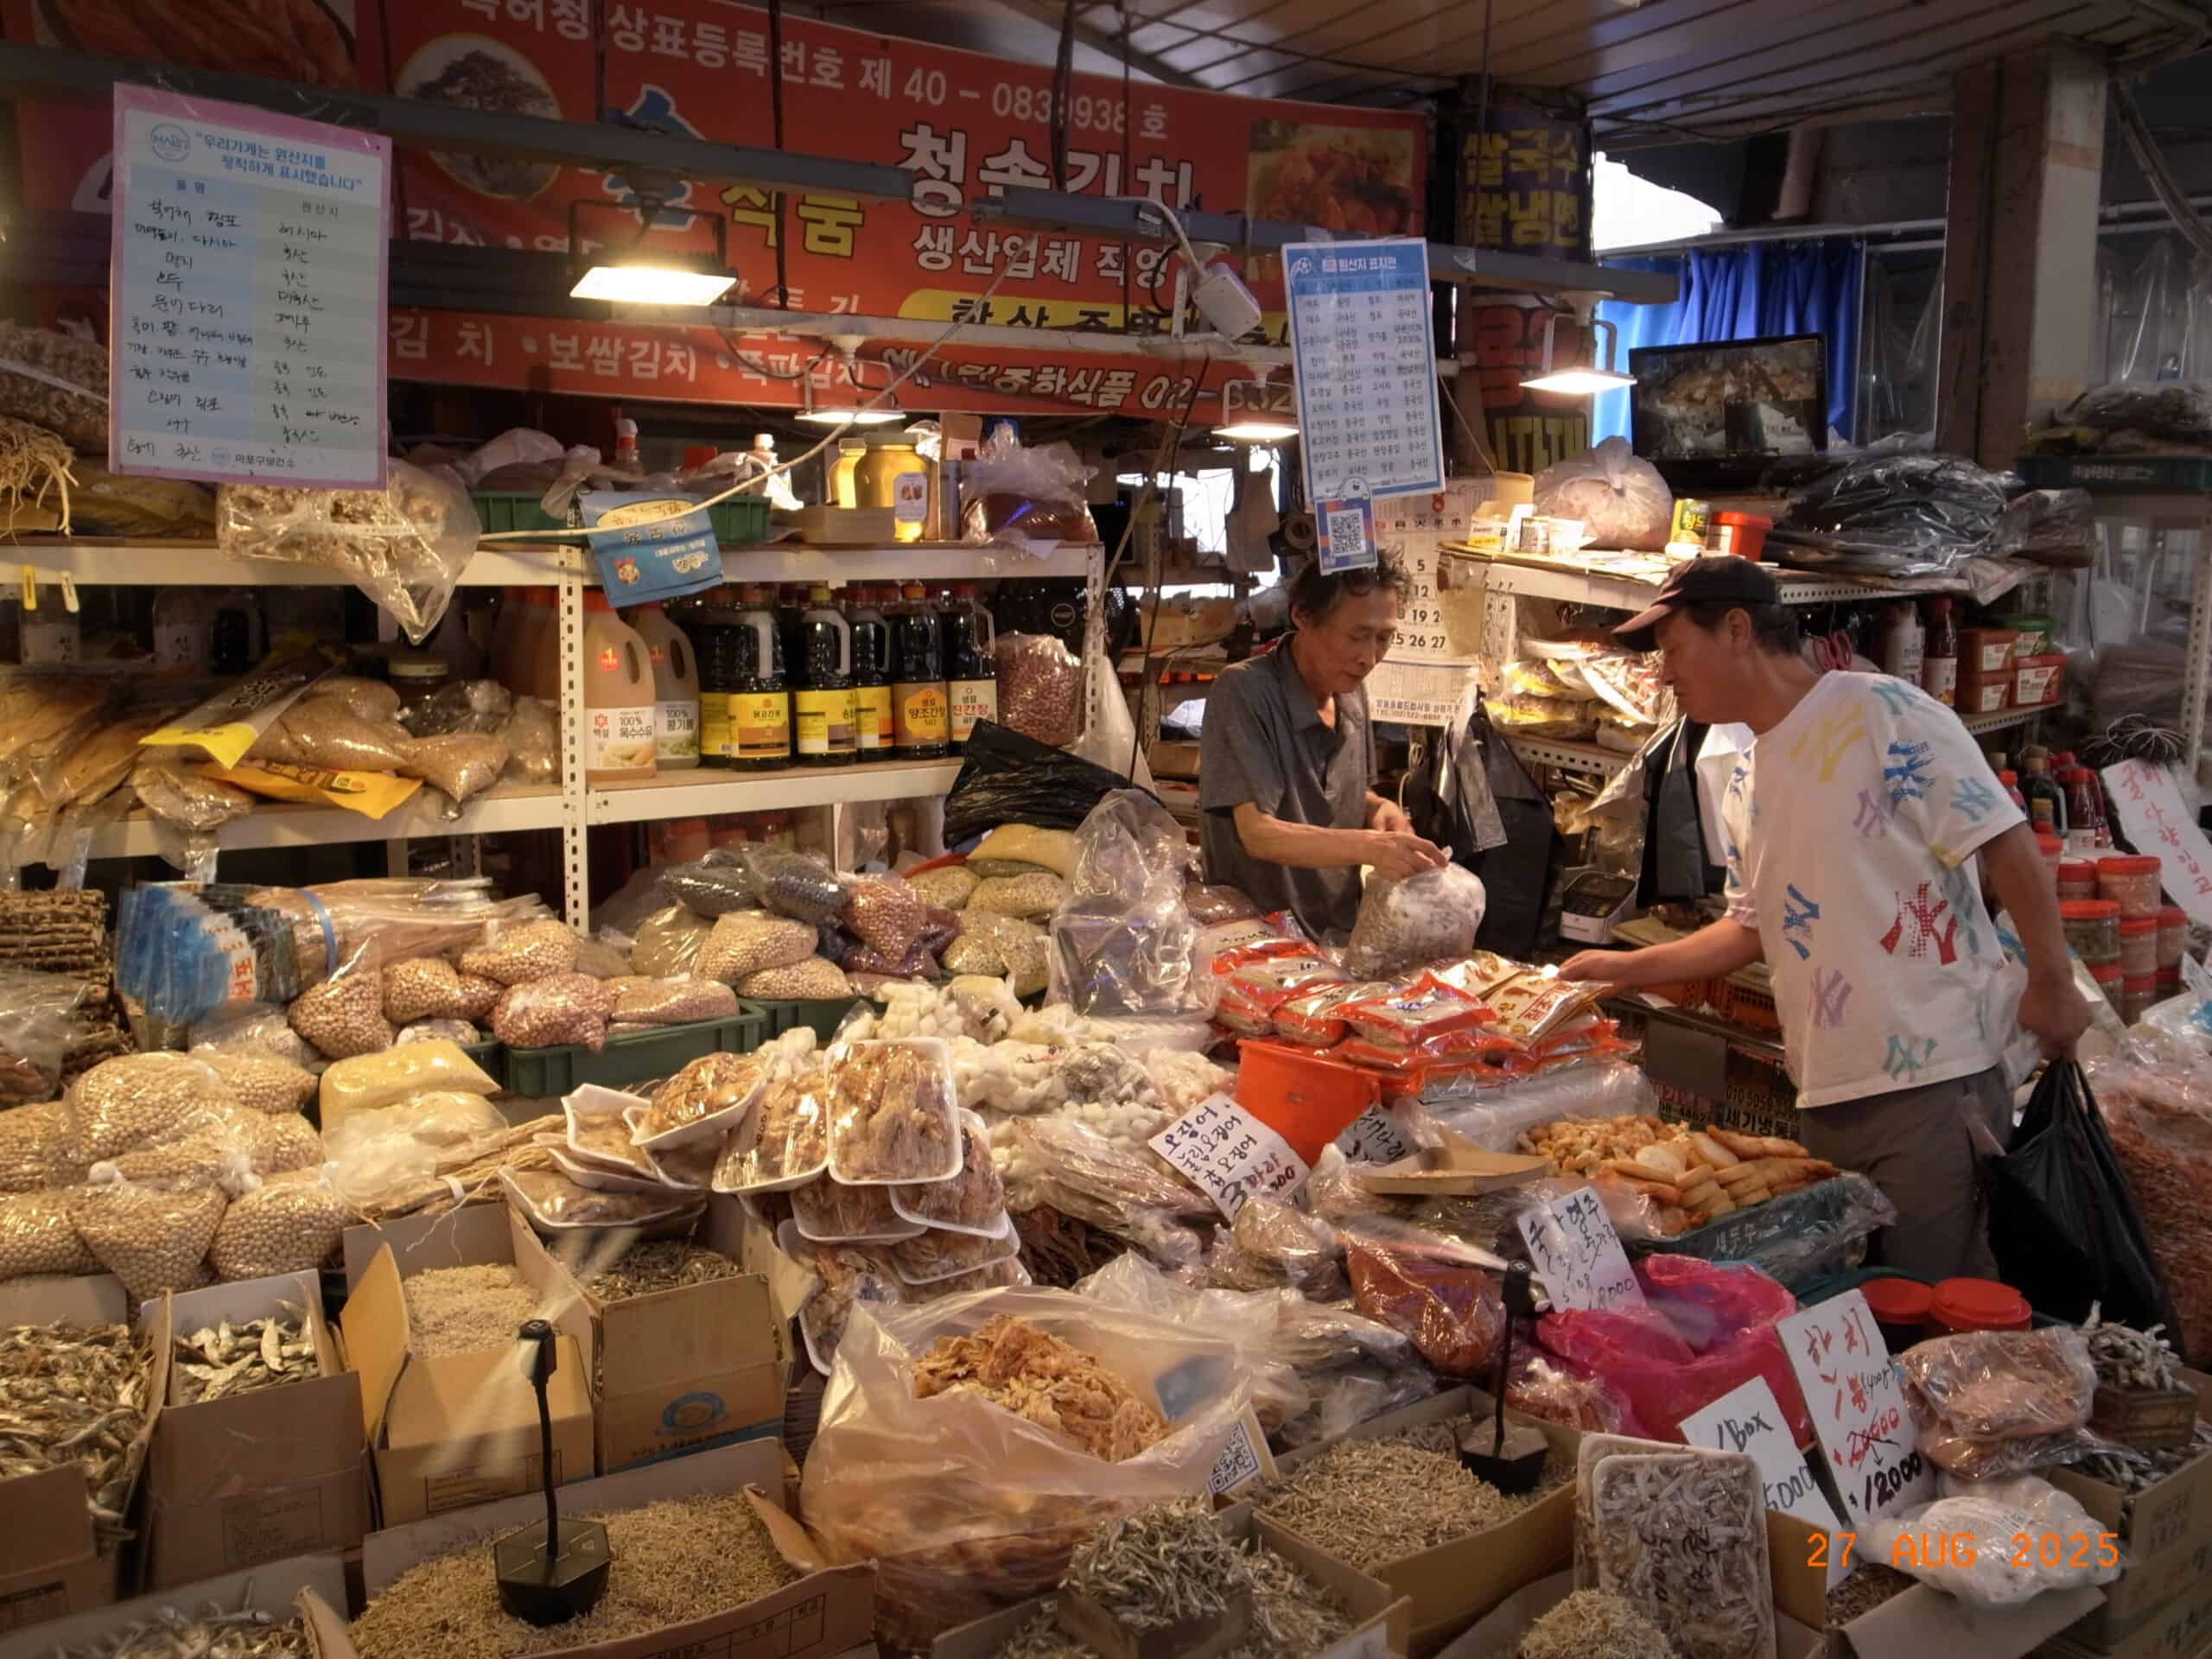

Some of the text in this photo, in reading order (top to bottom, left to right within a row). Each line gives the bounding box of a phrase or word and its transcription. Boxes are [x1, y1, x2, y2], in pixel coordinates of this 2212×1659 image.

[860, 57, 891, 100] 제
[905, 67, 947, 105] 40
[1140, 104, 1168, 140] 호
[912, 222, 1081, 284] 생산업체
[549, 333, 696, 382] 보쌈김치
[1417, 560, 1426, 571] 5
[1414, 586, 1429, 597] 12
[1412, 609, 1428, 622] 19
[1409, 634, 1427, 647] 26
[1431, 635, 1446, 649] 27
[666, 709, 689, 719] 100%
[908, 706, 946, 720] 양조간장
[952, 704, 989, 717] 진간장
[620, 716, 643, 727] 100%
[1164, 1105, 1219, 1156] 오징어
[1217, 1134, 1259, 1173] 오징어
